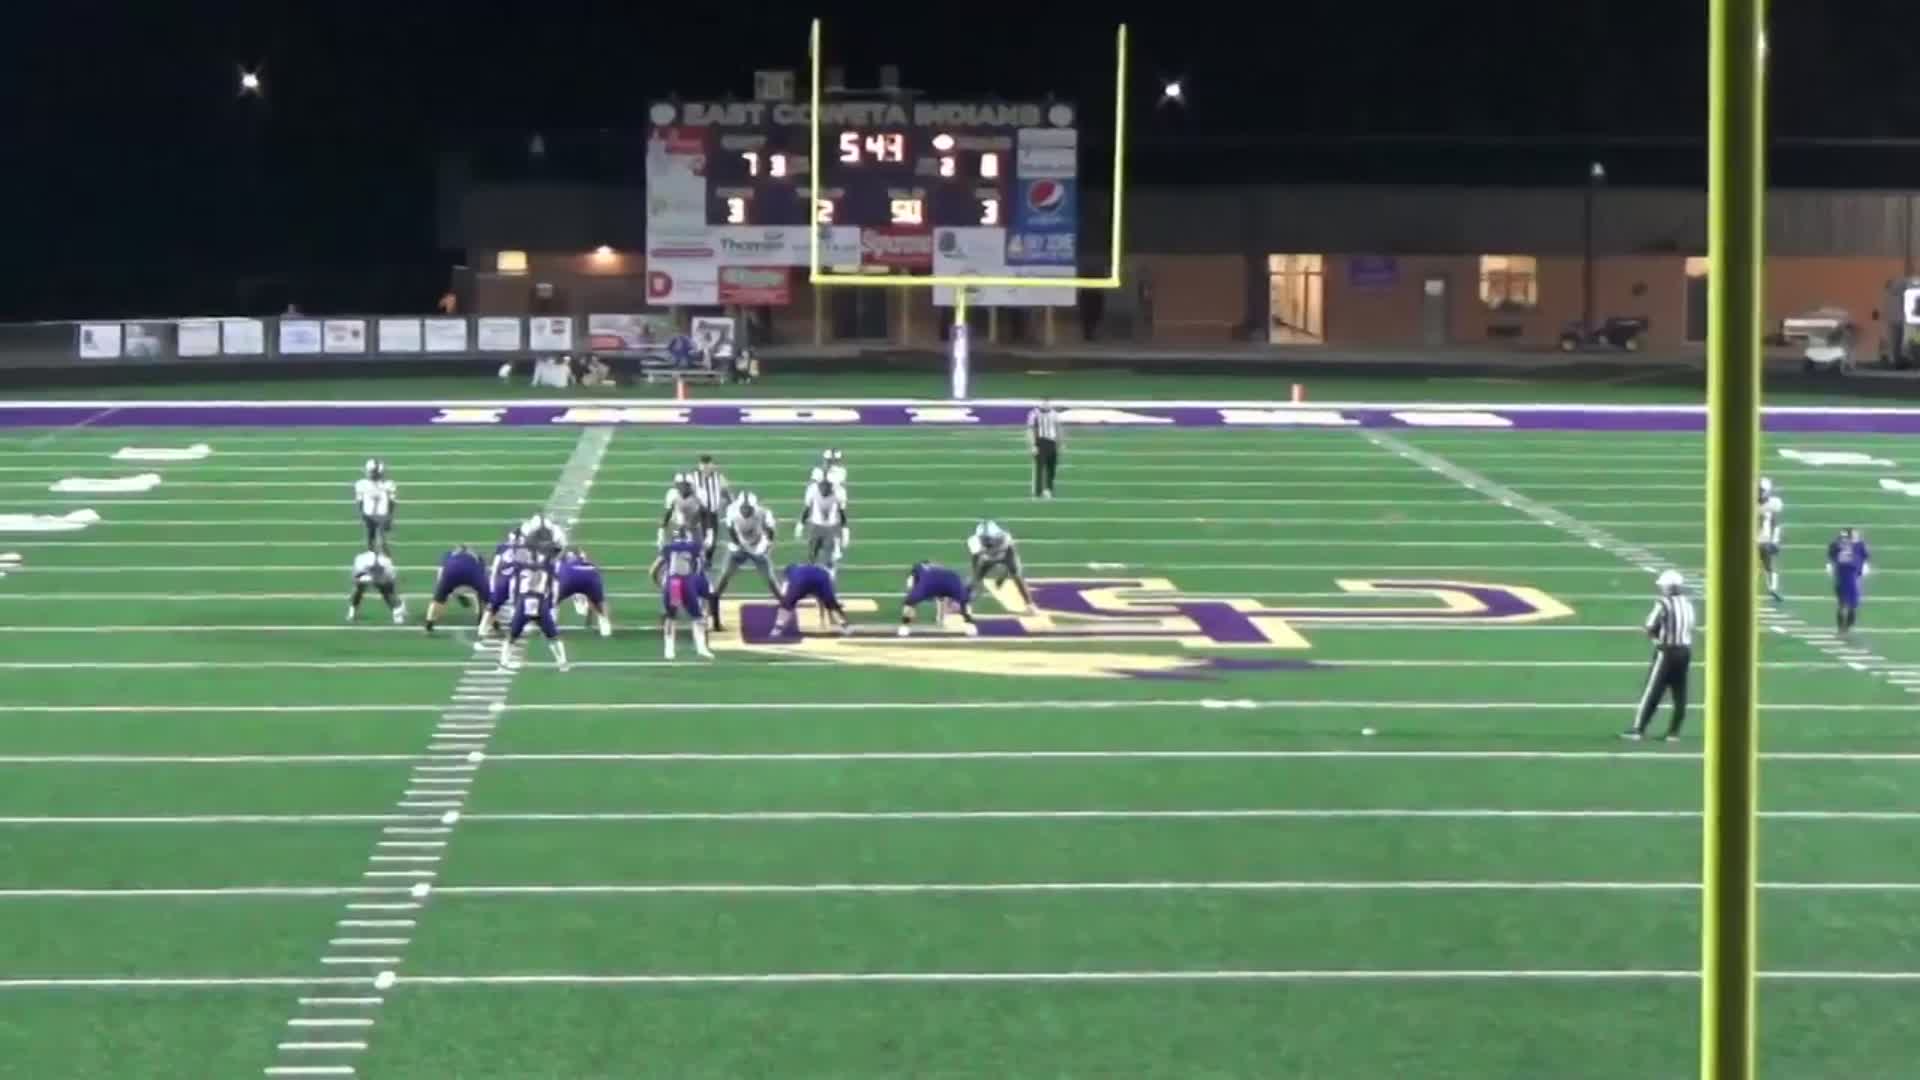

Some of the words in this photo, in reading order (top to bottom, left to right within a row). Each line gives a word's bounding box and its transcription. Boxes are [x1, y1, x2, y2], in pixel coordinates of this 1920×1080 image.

[682, 103, 766, 125] EAST
[727, 197, 744, 223] 3
[980, 199, 998, 224] 3
